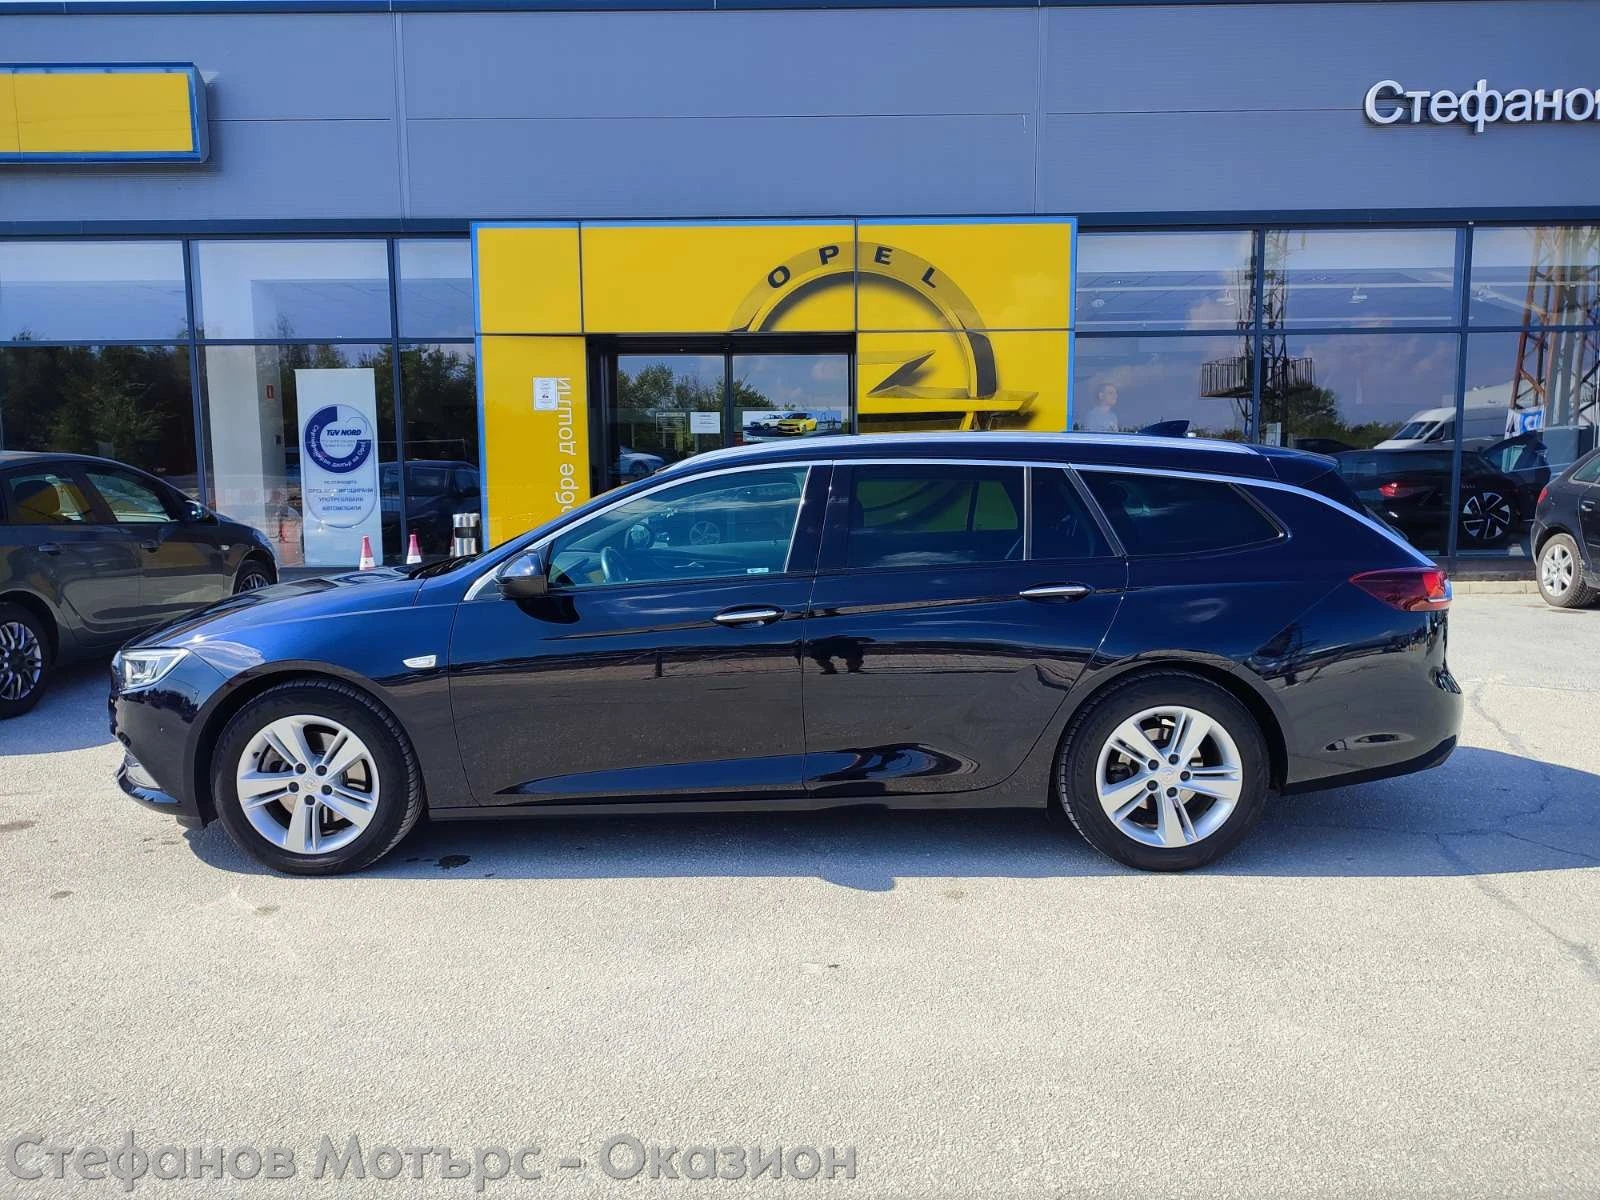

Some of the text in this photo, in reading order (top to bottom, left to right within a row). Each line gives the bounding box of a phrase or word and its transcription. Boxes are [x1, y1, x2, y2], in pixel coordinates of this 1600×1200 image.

[1365, 79, 1600, 133] Стефано
[767, 244, 937, 289] OPEL
[557, 377, 577, 456] дошли
